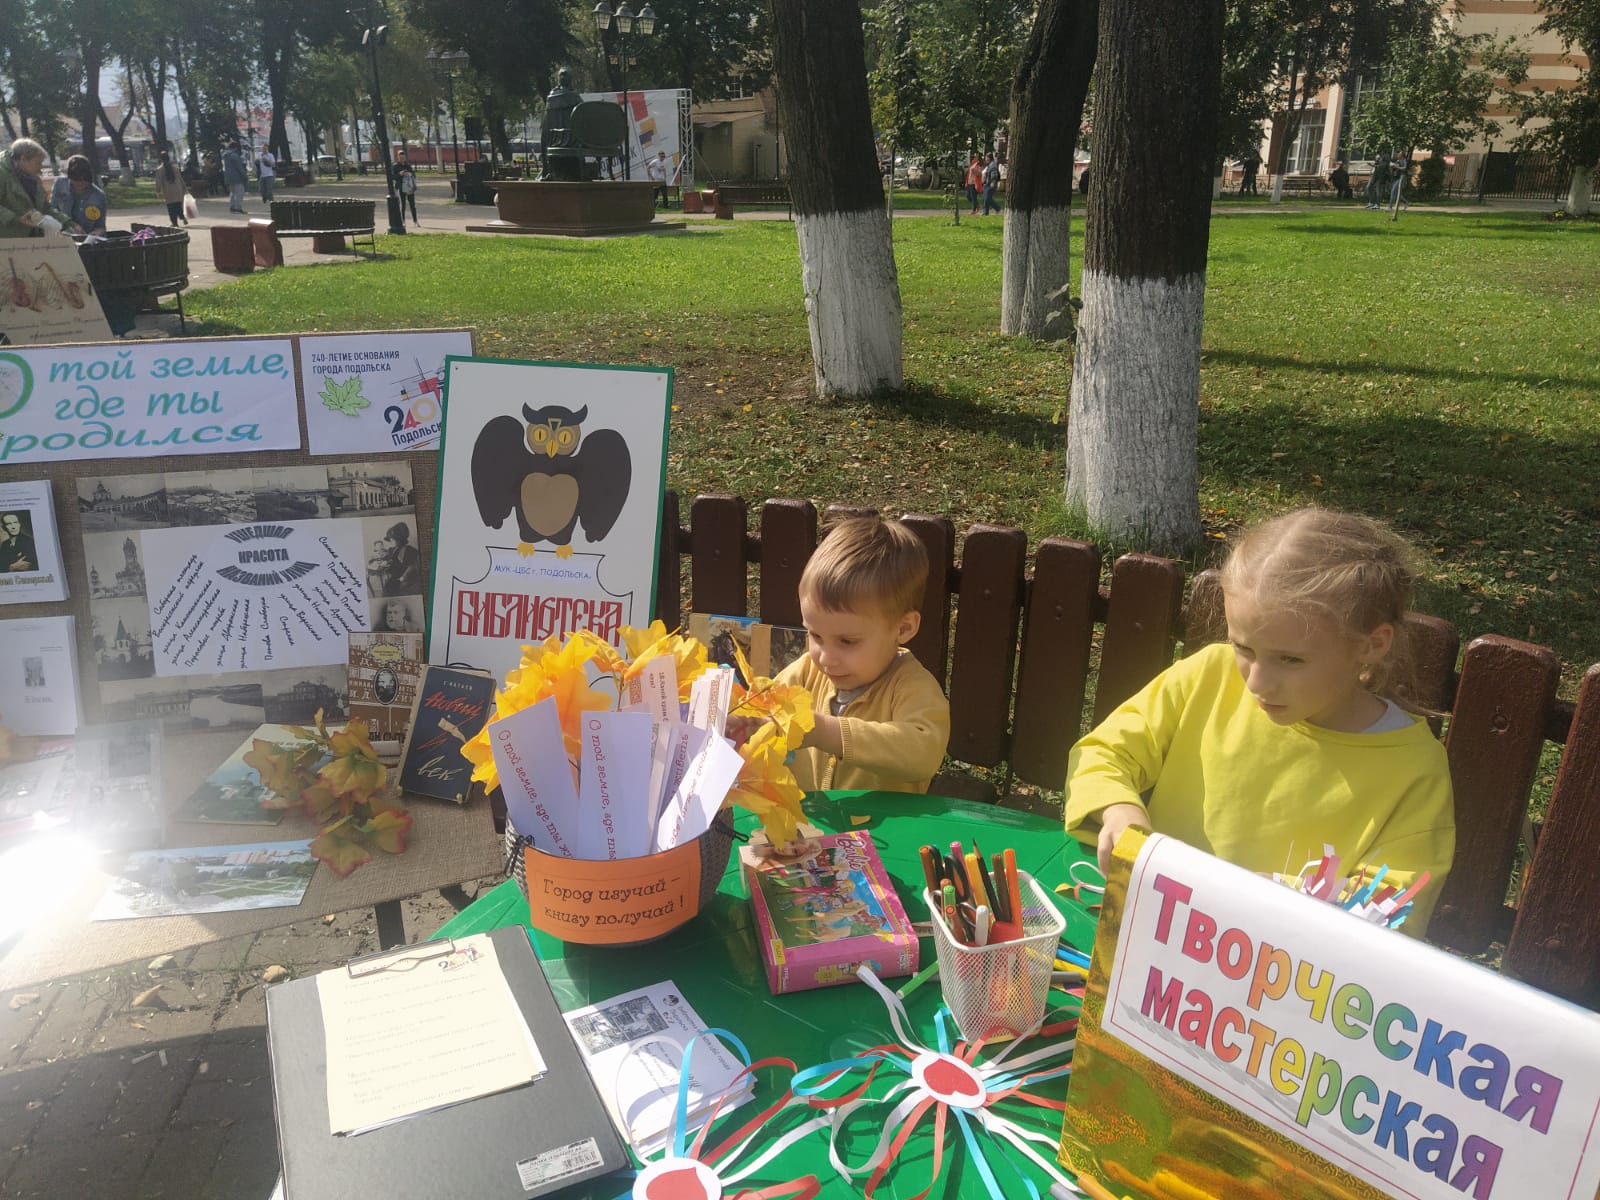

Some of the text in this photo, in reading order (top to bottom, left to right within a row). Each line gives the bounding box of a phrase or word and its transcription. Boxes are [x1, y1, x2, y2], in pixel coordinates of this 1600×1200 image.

[49, 350, 136, 383] той
[150, 353, 290, 380] земле,
[311, 350, 400, 363] 240-ЛЕТИЕ ОСНОВАНИЯ
[312, 362, 392, 374] ГОРОДА ПОДОЛЬСКА
[54, 384, 223, 420] где ты
[0, 421, 263, 460] родился
[224, 525, 294, 544] УШЕДШАЯ
[238, 548, 290, 564] КРАСОТА
[216, 561, 320, 586] НАЗВАНИЙ УЛИЦ
[456, 590, 623, 647] БИБЛИОТЕКА
[498, 729, 511, 741] О
[589, 719, 602, 731] О
[503, 743, 521, 765] той
[592, 735, 605, 761] той
[515, 767, 538, 803] земле,
[597, 765, 610, 809] земле,
[535, 804, 550, 822] где
[602, 812, 614, 834] где
[546, 823, 562, 843] ты
[836, 837, 869, 870] Barbie
[543, 879, 594, 903] Город
[598, 879, 666, 903] изучай
[544, 906, 590, 927] книгу
[595, 901, 675, 925] получай
[1153, 872, 1563, 1135] Творческая
[1140, 965, 1503, 1200] мастерская
